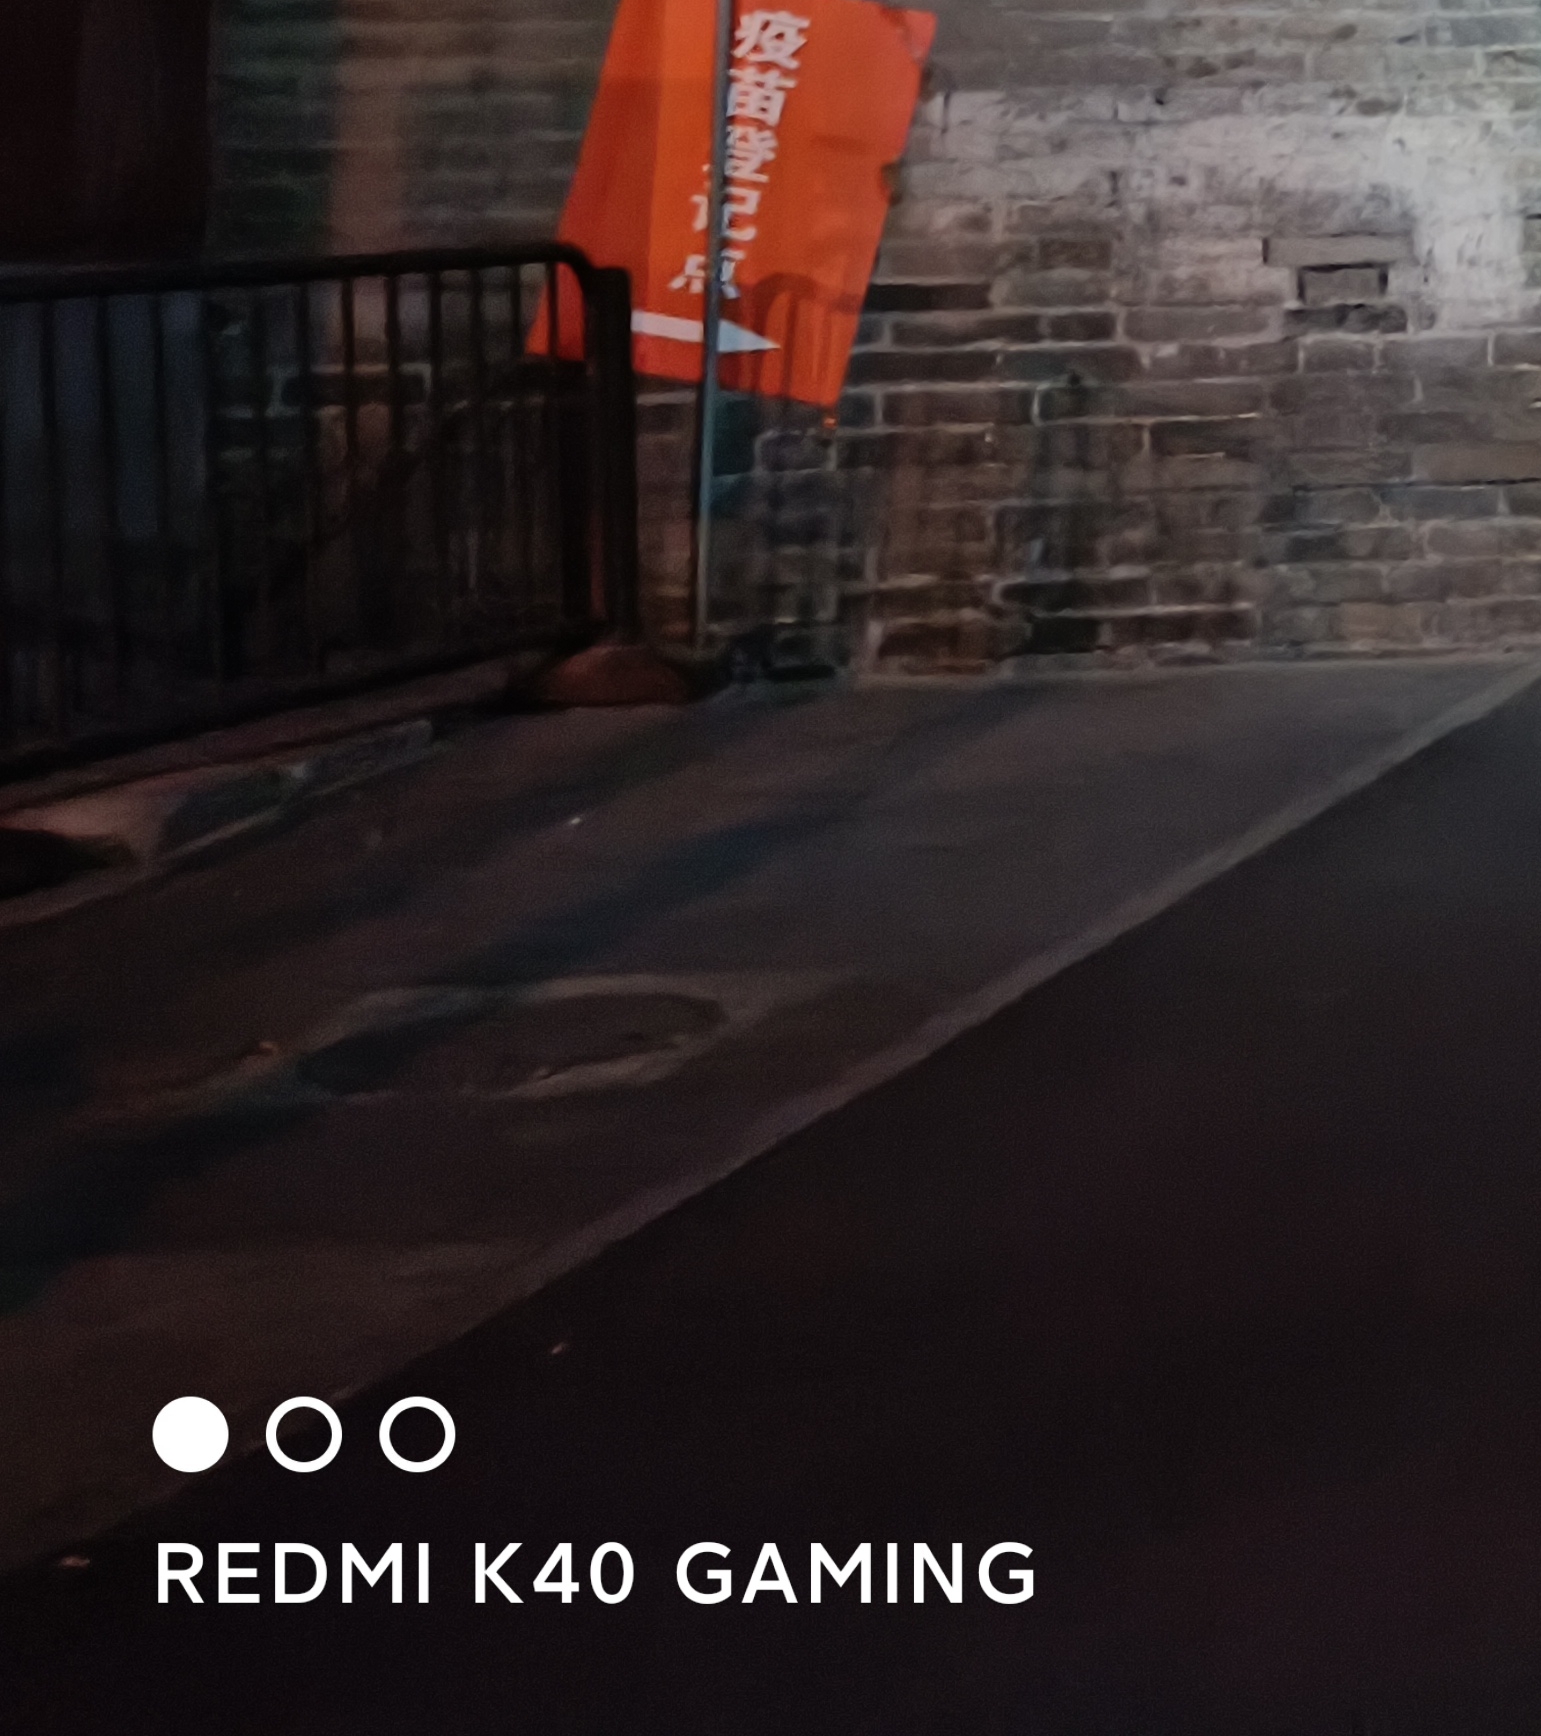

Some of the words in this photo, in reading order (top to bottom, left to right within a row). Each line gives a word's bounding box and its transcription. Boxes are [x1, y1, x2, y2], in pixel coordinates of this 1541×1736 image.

[667, 10, 811, 300] 疫苗登记点
